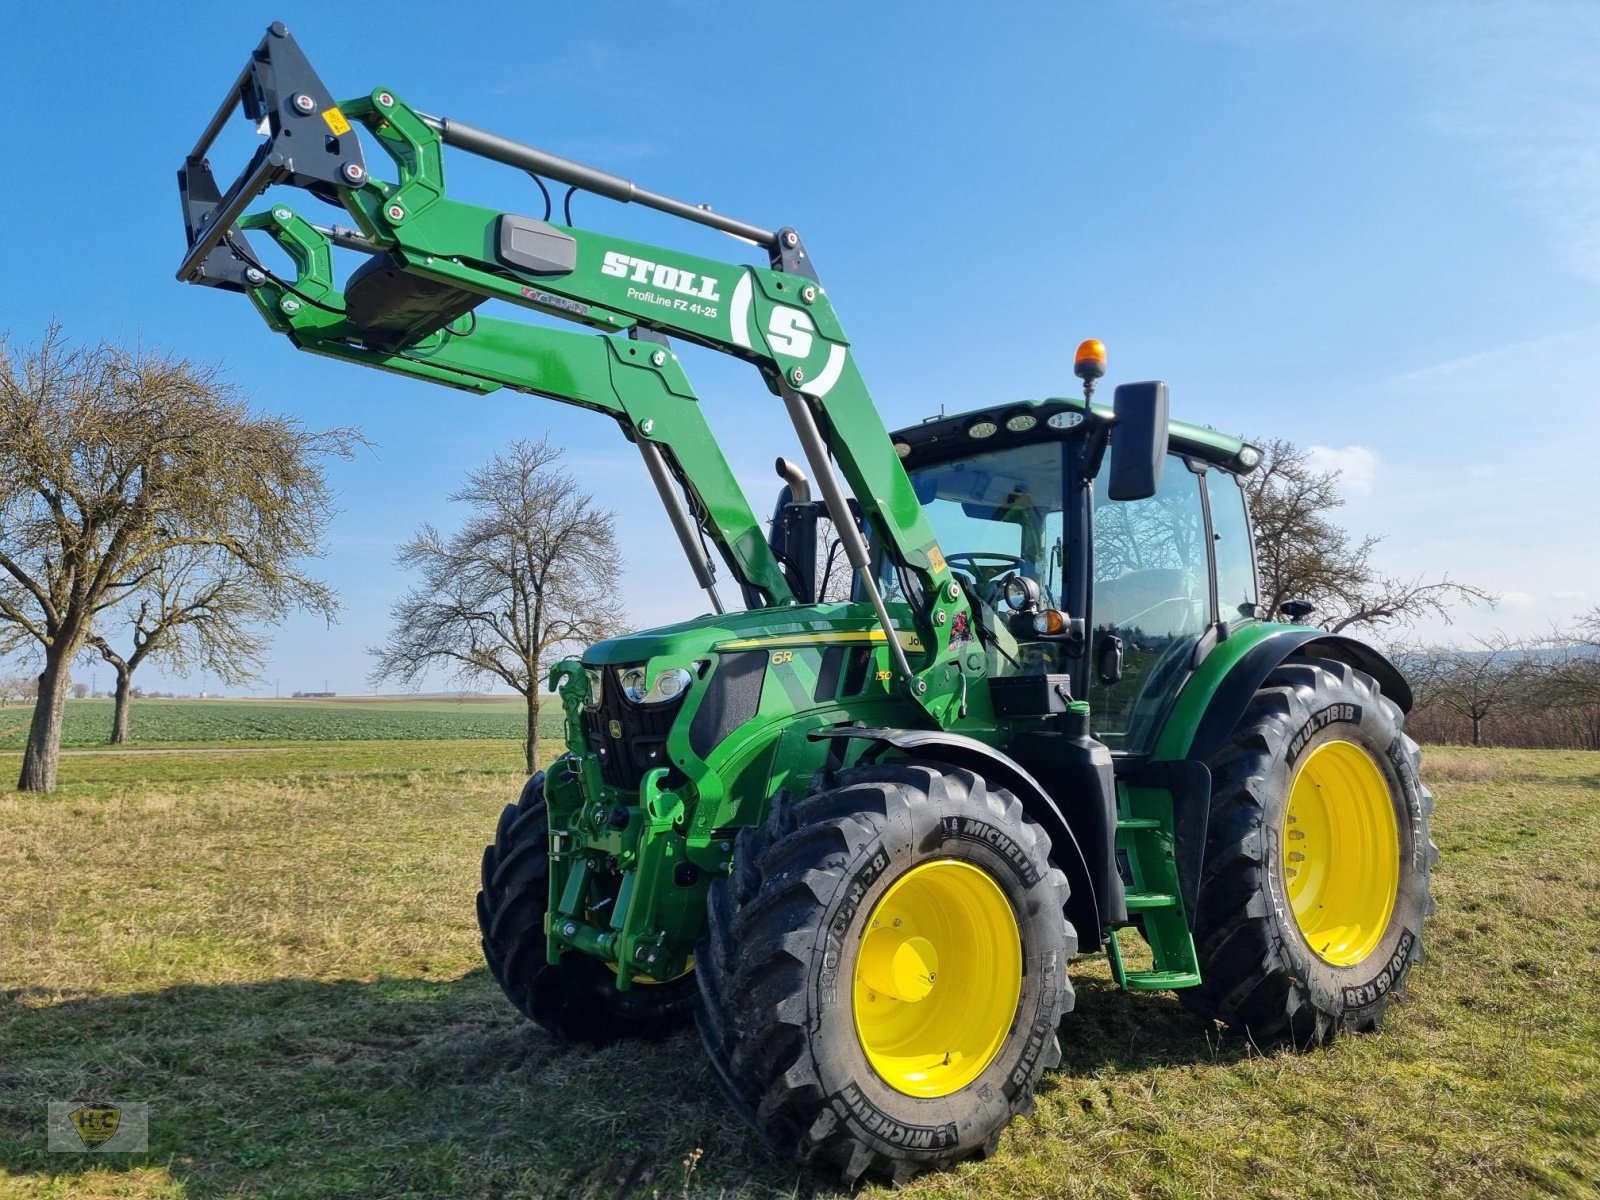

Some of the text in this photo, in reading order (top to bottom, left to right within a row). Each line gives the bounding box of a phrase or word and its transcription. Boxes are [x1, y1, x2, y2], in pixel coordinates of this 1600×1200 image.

[601, 251, 720, 302] STOLL
[627, 287, 718, 318] ProfiLine FZ 41-25
[766, 305, 815, 359] S
[771, 651, 793, 666] 6R
[908, 636, 922, 646] Jo
[875, 671, 892, 682] 150
[1290, 704, 1355, 758] MULTIBIB
[862, 852, 887, 885] 28
[962, 818, 1038, 884] MICHELIN
[1345, 934, 1412, 1007] 650/65 R 38
[841, 1085, 934, 1148] MICHELIN
